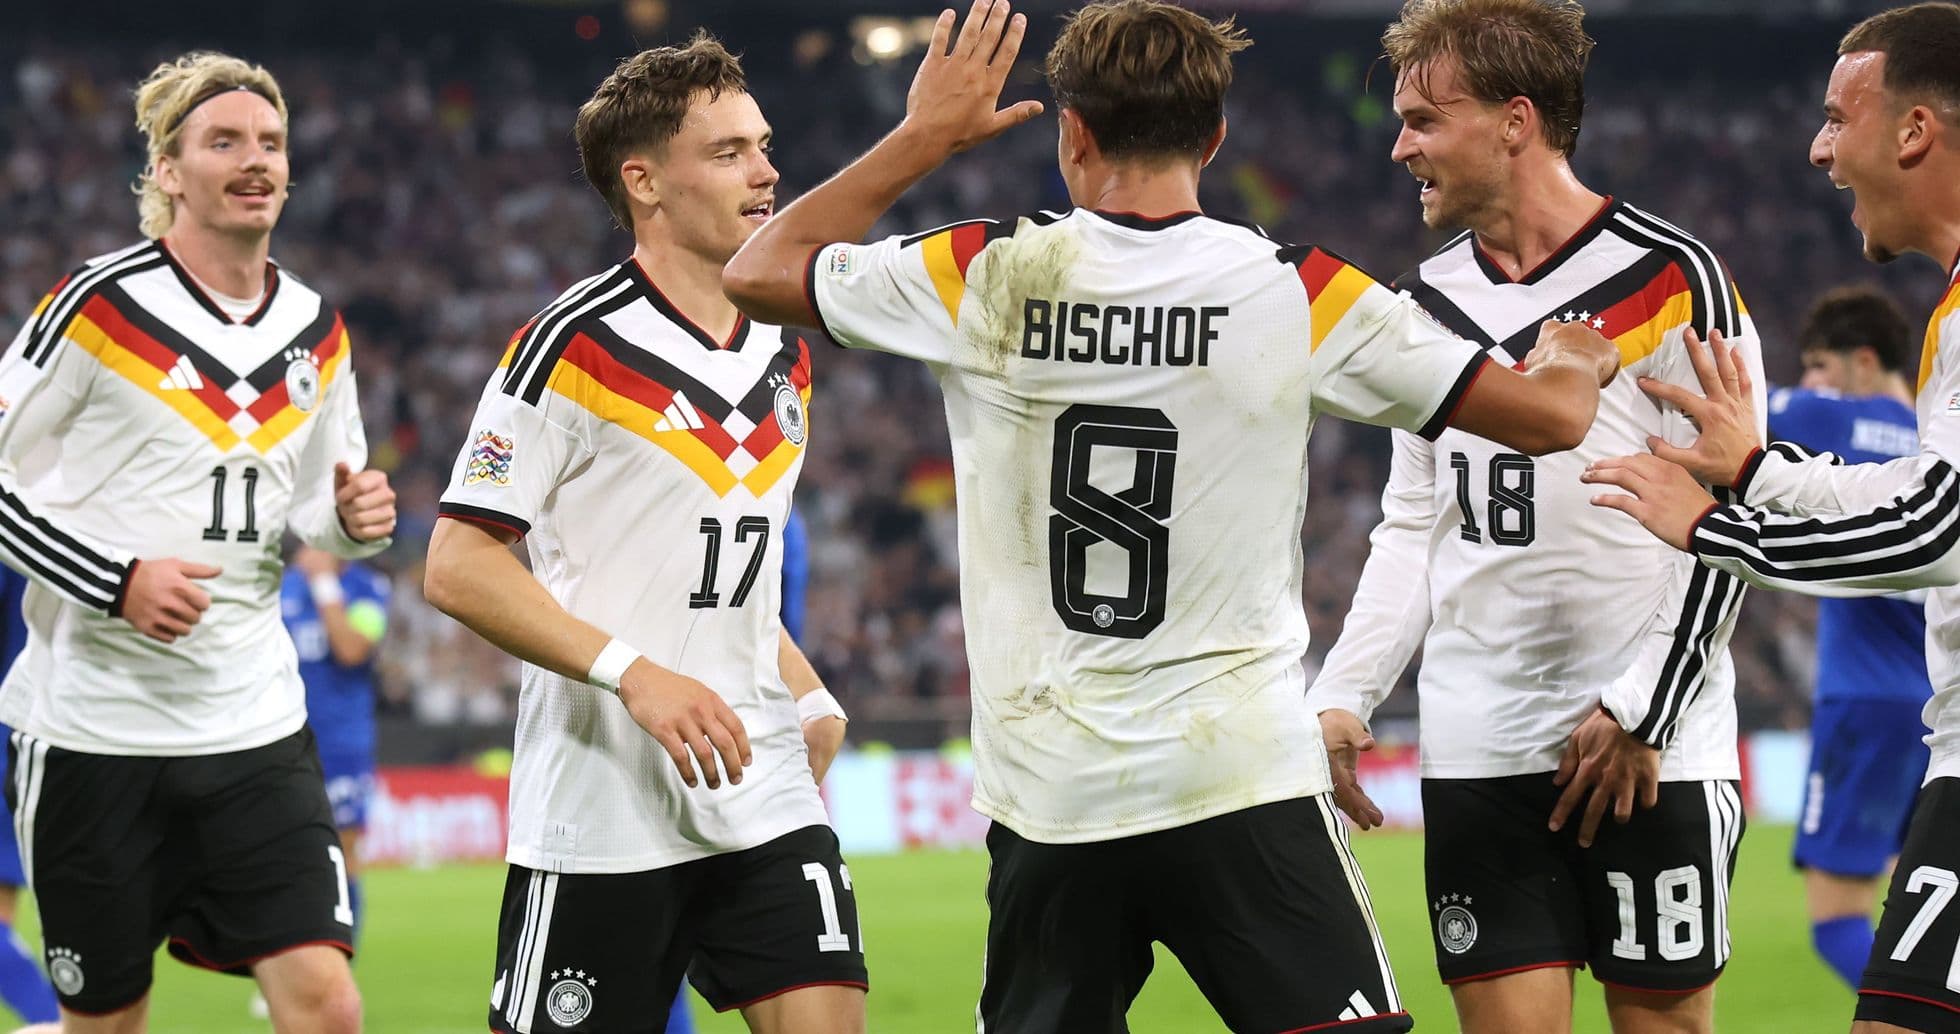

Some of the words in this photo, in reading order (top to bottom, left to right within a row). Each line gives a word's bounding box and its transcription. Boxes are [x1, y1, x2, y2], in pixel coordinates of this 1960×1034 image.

[1021, 298, 1229, 367] BISCHOF
[203, 465, 259, 543] 11
[1049, 403, 1179, 639] 8
[1450, 451, 1536, 546] 18
[689, 516, 770, 609] 17
[802, 862, 864, 954] 1
[1606, 864, 1704, 962] 18
[1890, 865, 1960, 994] 7
